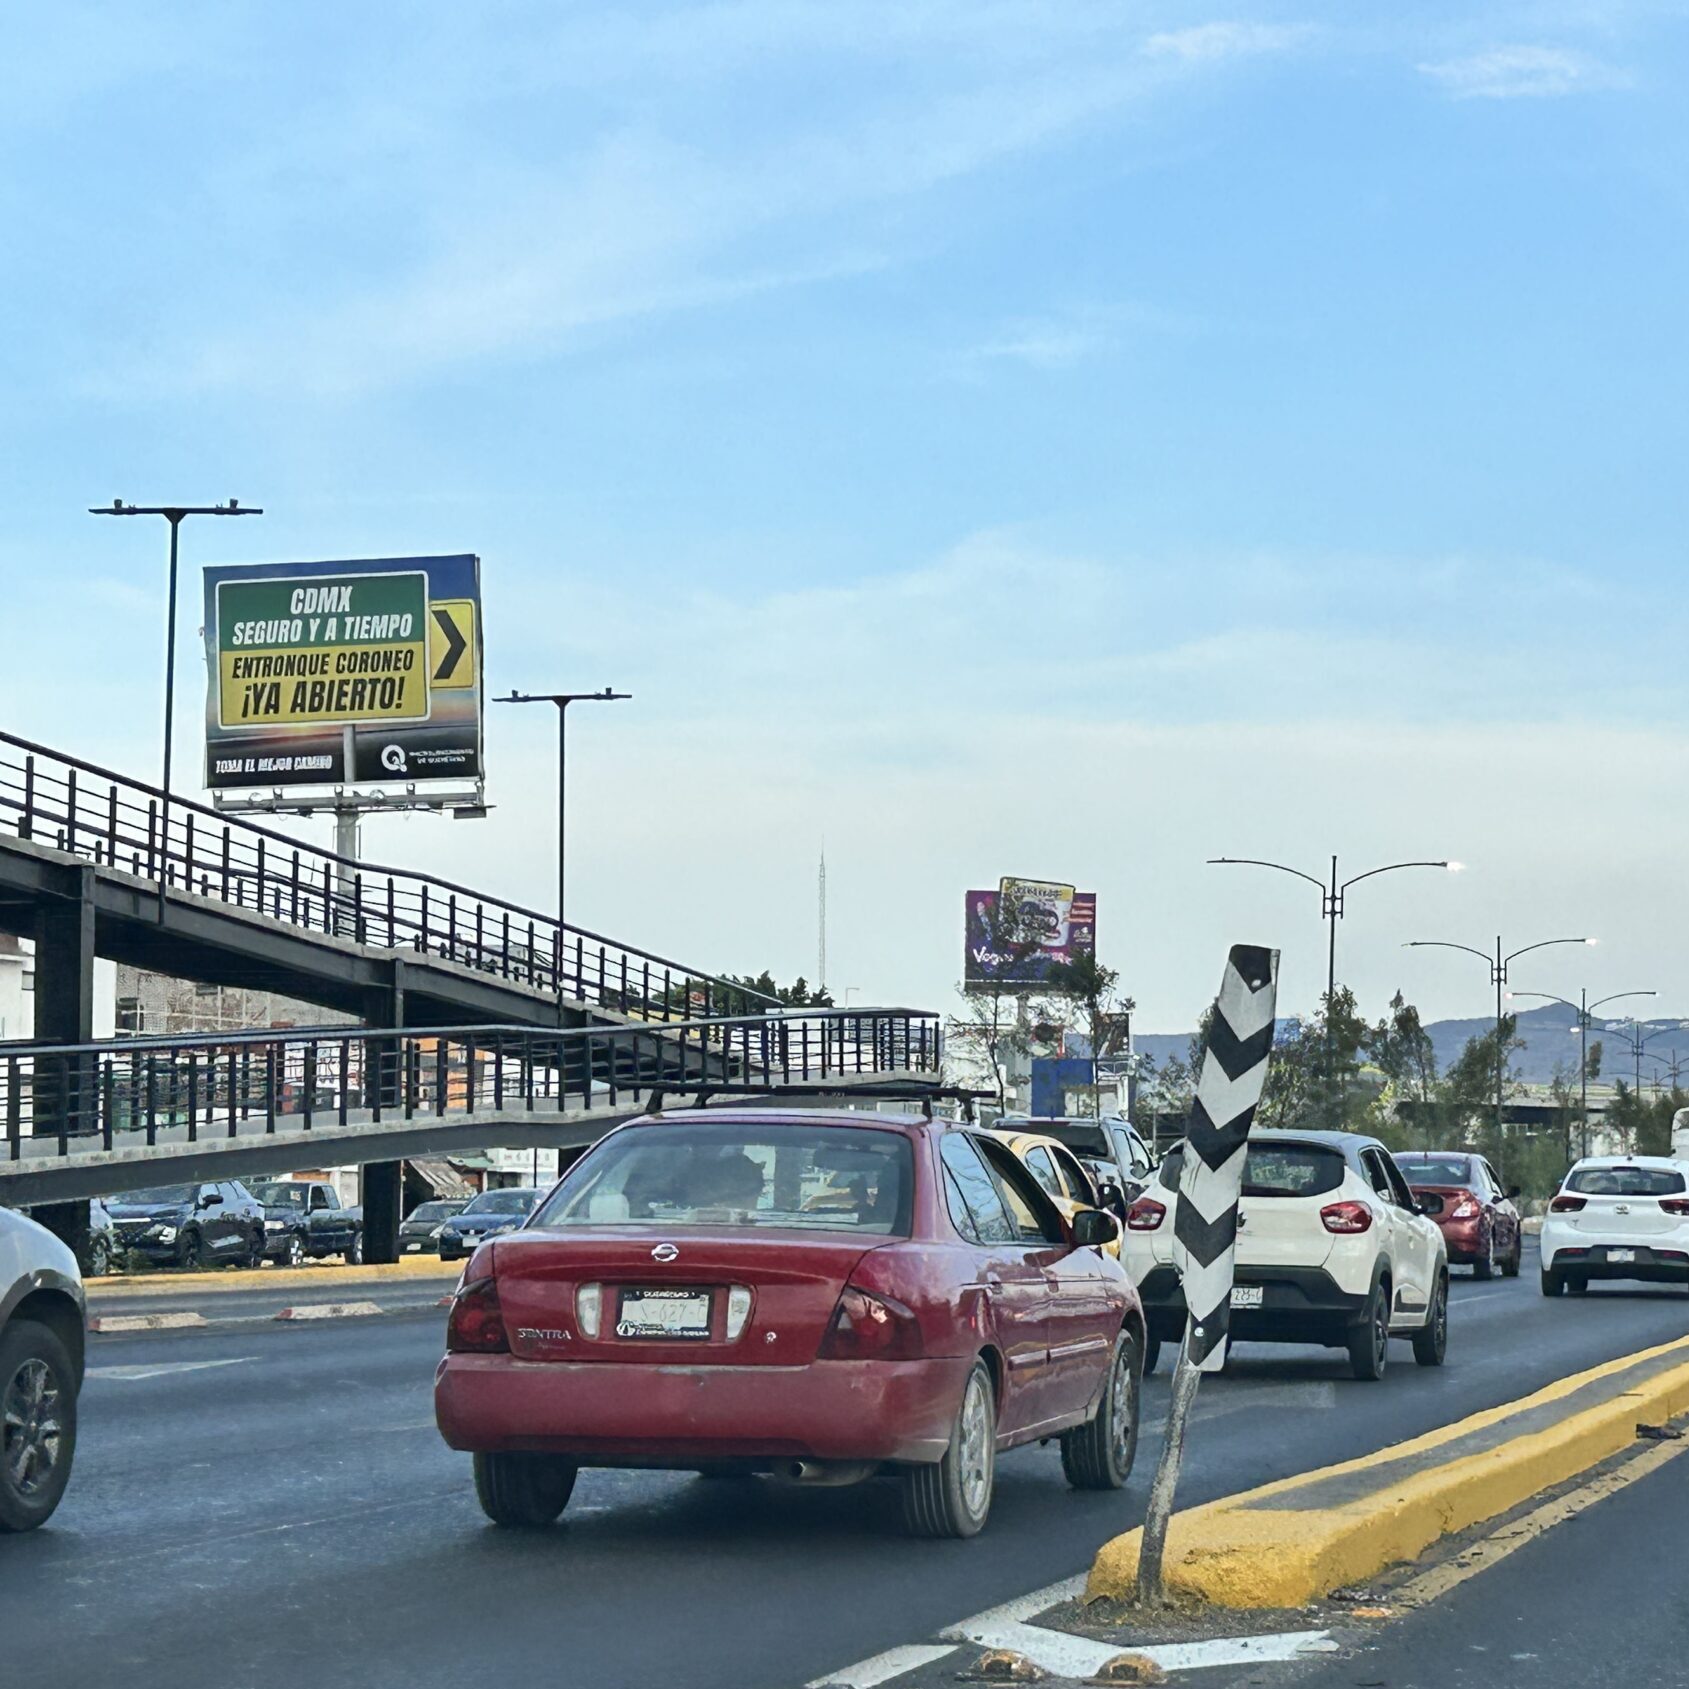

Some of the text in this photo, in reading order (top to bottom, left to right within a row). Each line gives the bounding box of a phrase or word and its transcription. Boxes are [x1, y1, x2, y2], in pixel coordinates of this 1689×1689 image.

[290, 585, 353, 615] CDMX
[232, 613, 413, 645] SEGURO Y A TIEMPO
[232, 649, 414, 679] ENTRONQUE CORONEO
[242, 676, 405, 718] ¡YA ABIERTO!
